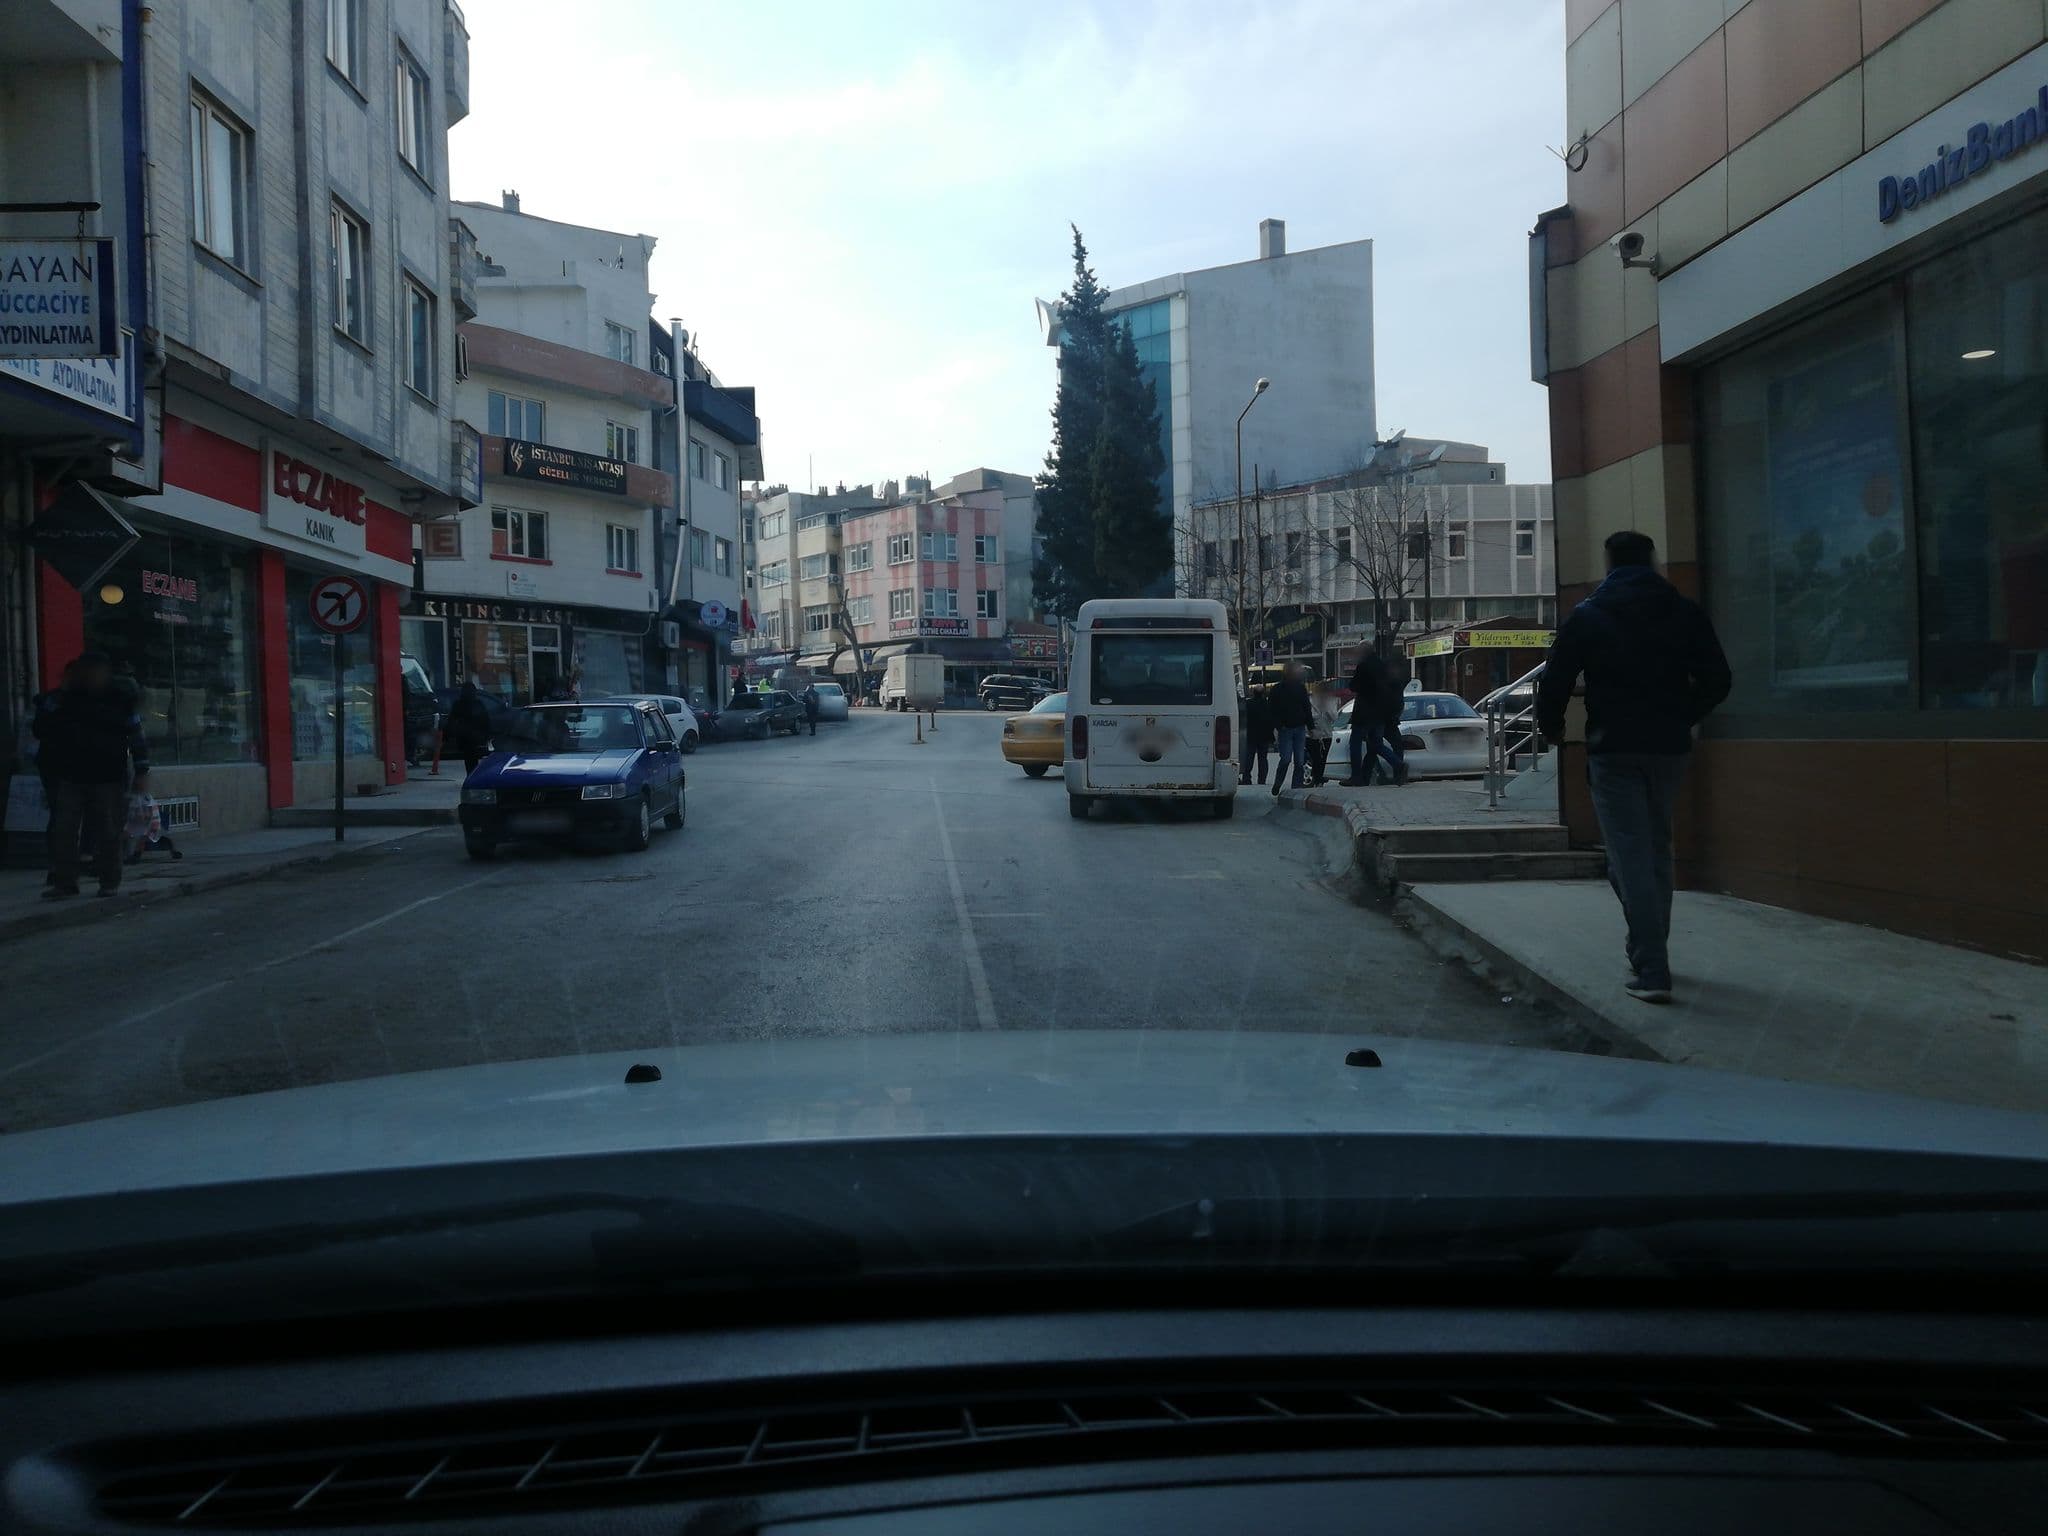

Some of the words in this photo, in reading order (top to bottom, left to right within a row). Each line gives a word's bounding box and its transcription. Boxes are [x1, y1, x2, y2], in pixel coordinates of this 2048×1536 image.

[0, 256, 93, 283] AYAN
[53, 360, 117, 408] AYDINLATMA
[531, 445, 576, 467] İSTANBUL
[273, 451, 365, 526] ECZANE
[306, 518, 335, 543] KANIK
[143, 570, 198, 602] ECZANE
